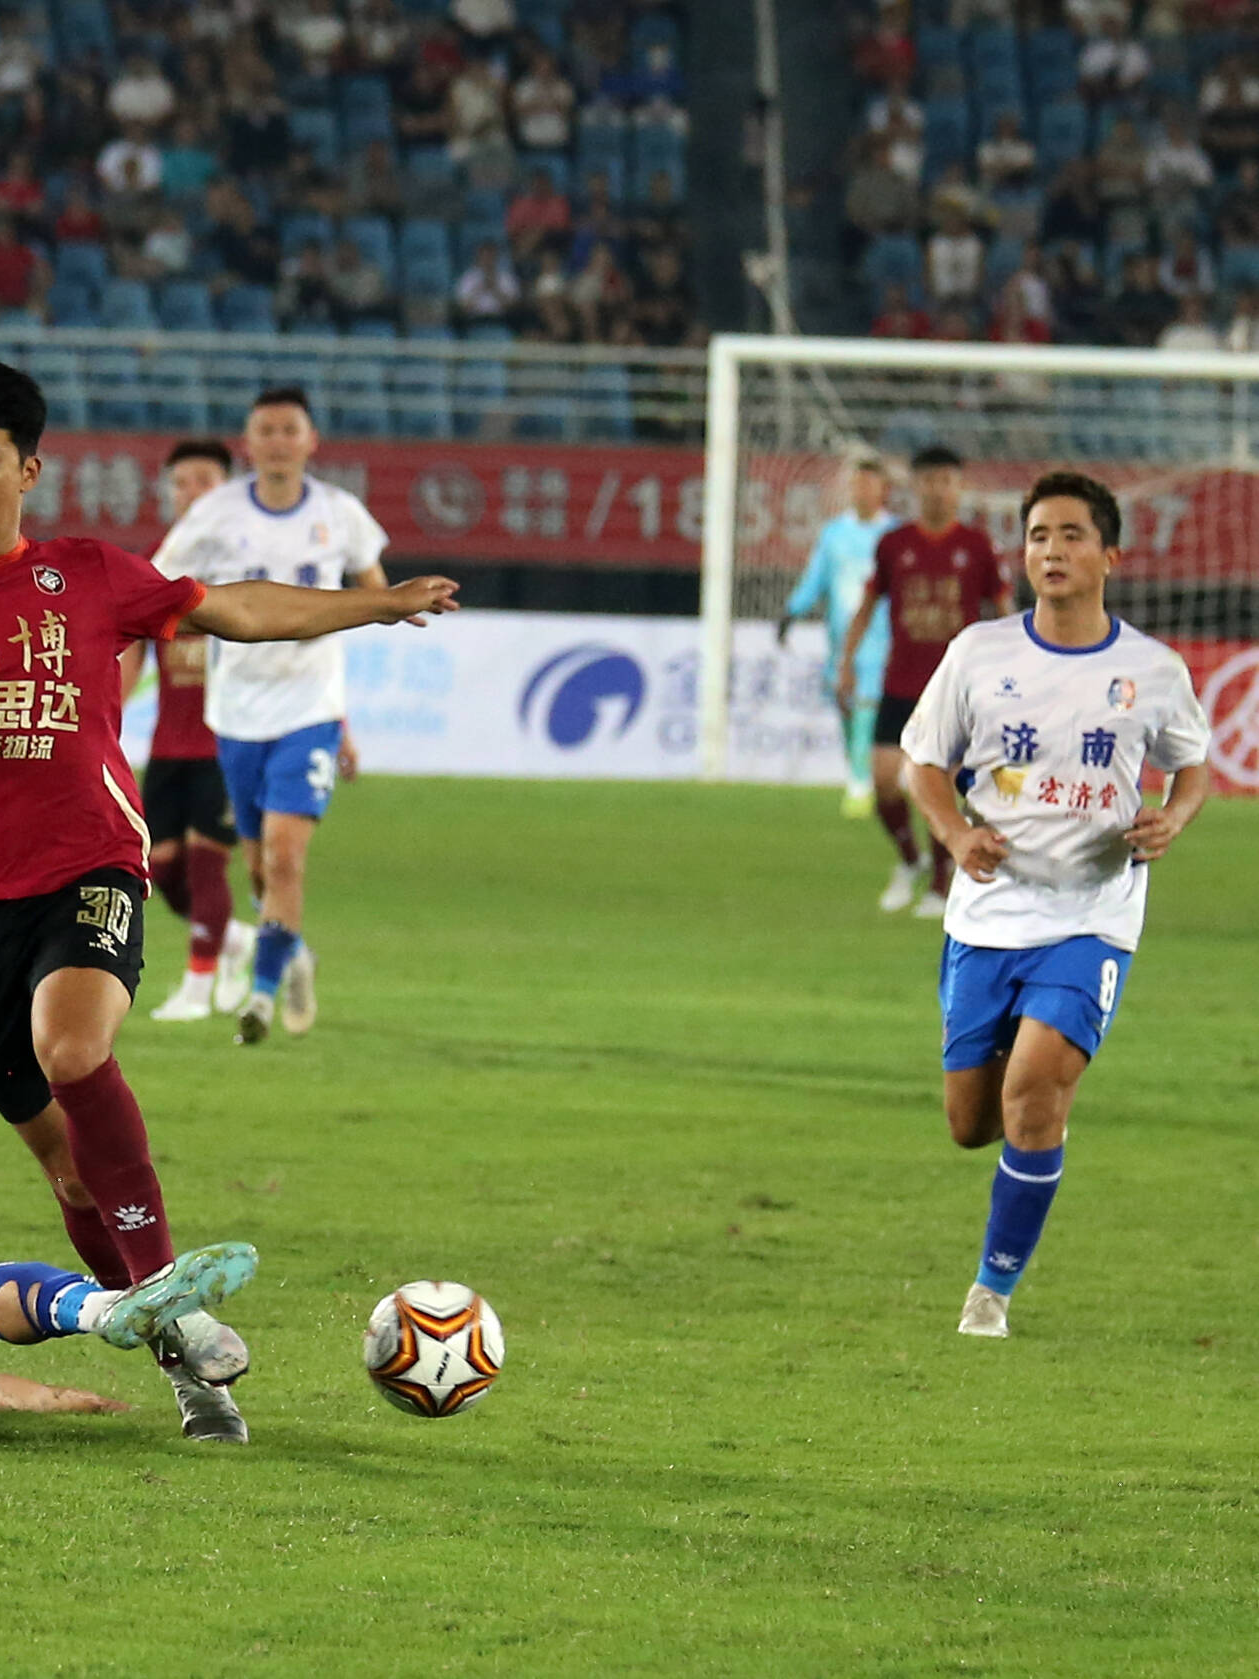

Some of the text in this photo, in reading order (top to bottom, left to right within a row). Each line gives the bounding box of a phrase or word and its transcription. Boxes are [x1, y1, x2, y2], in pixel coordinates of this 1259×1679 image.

[1001, 722, 1117, 769] 济南
[76, 886, 133, 945] 30
[1099, 958, 1119, 1013] 8
